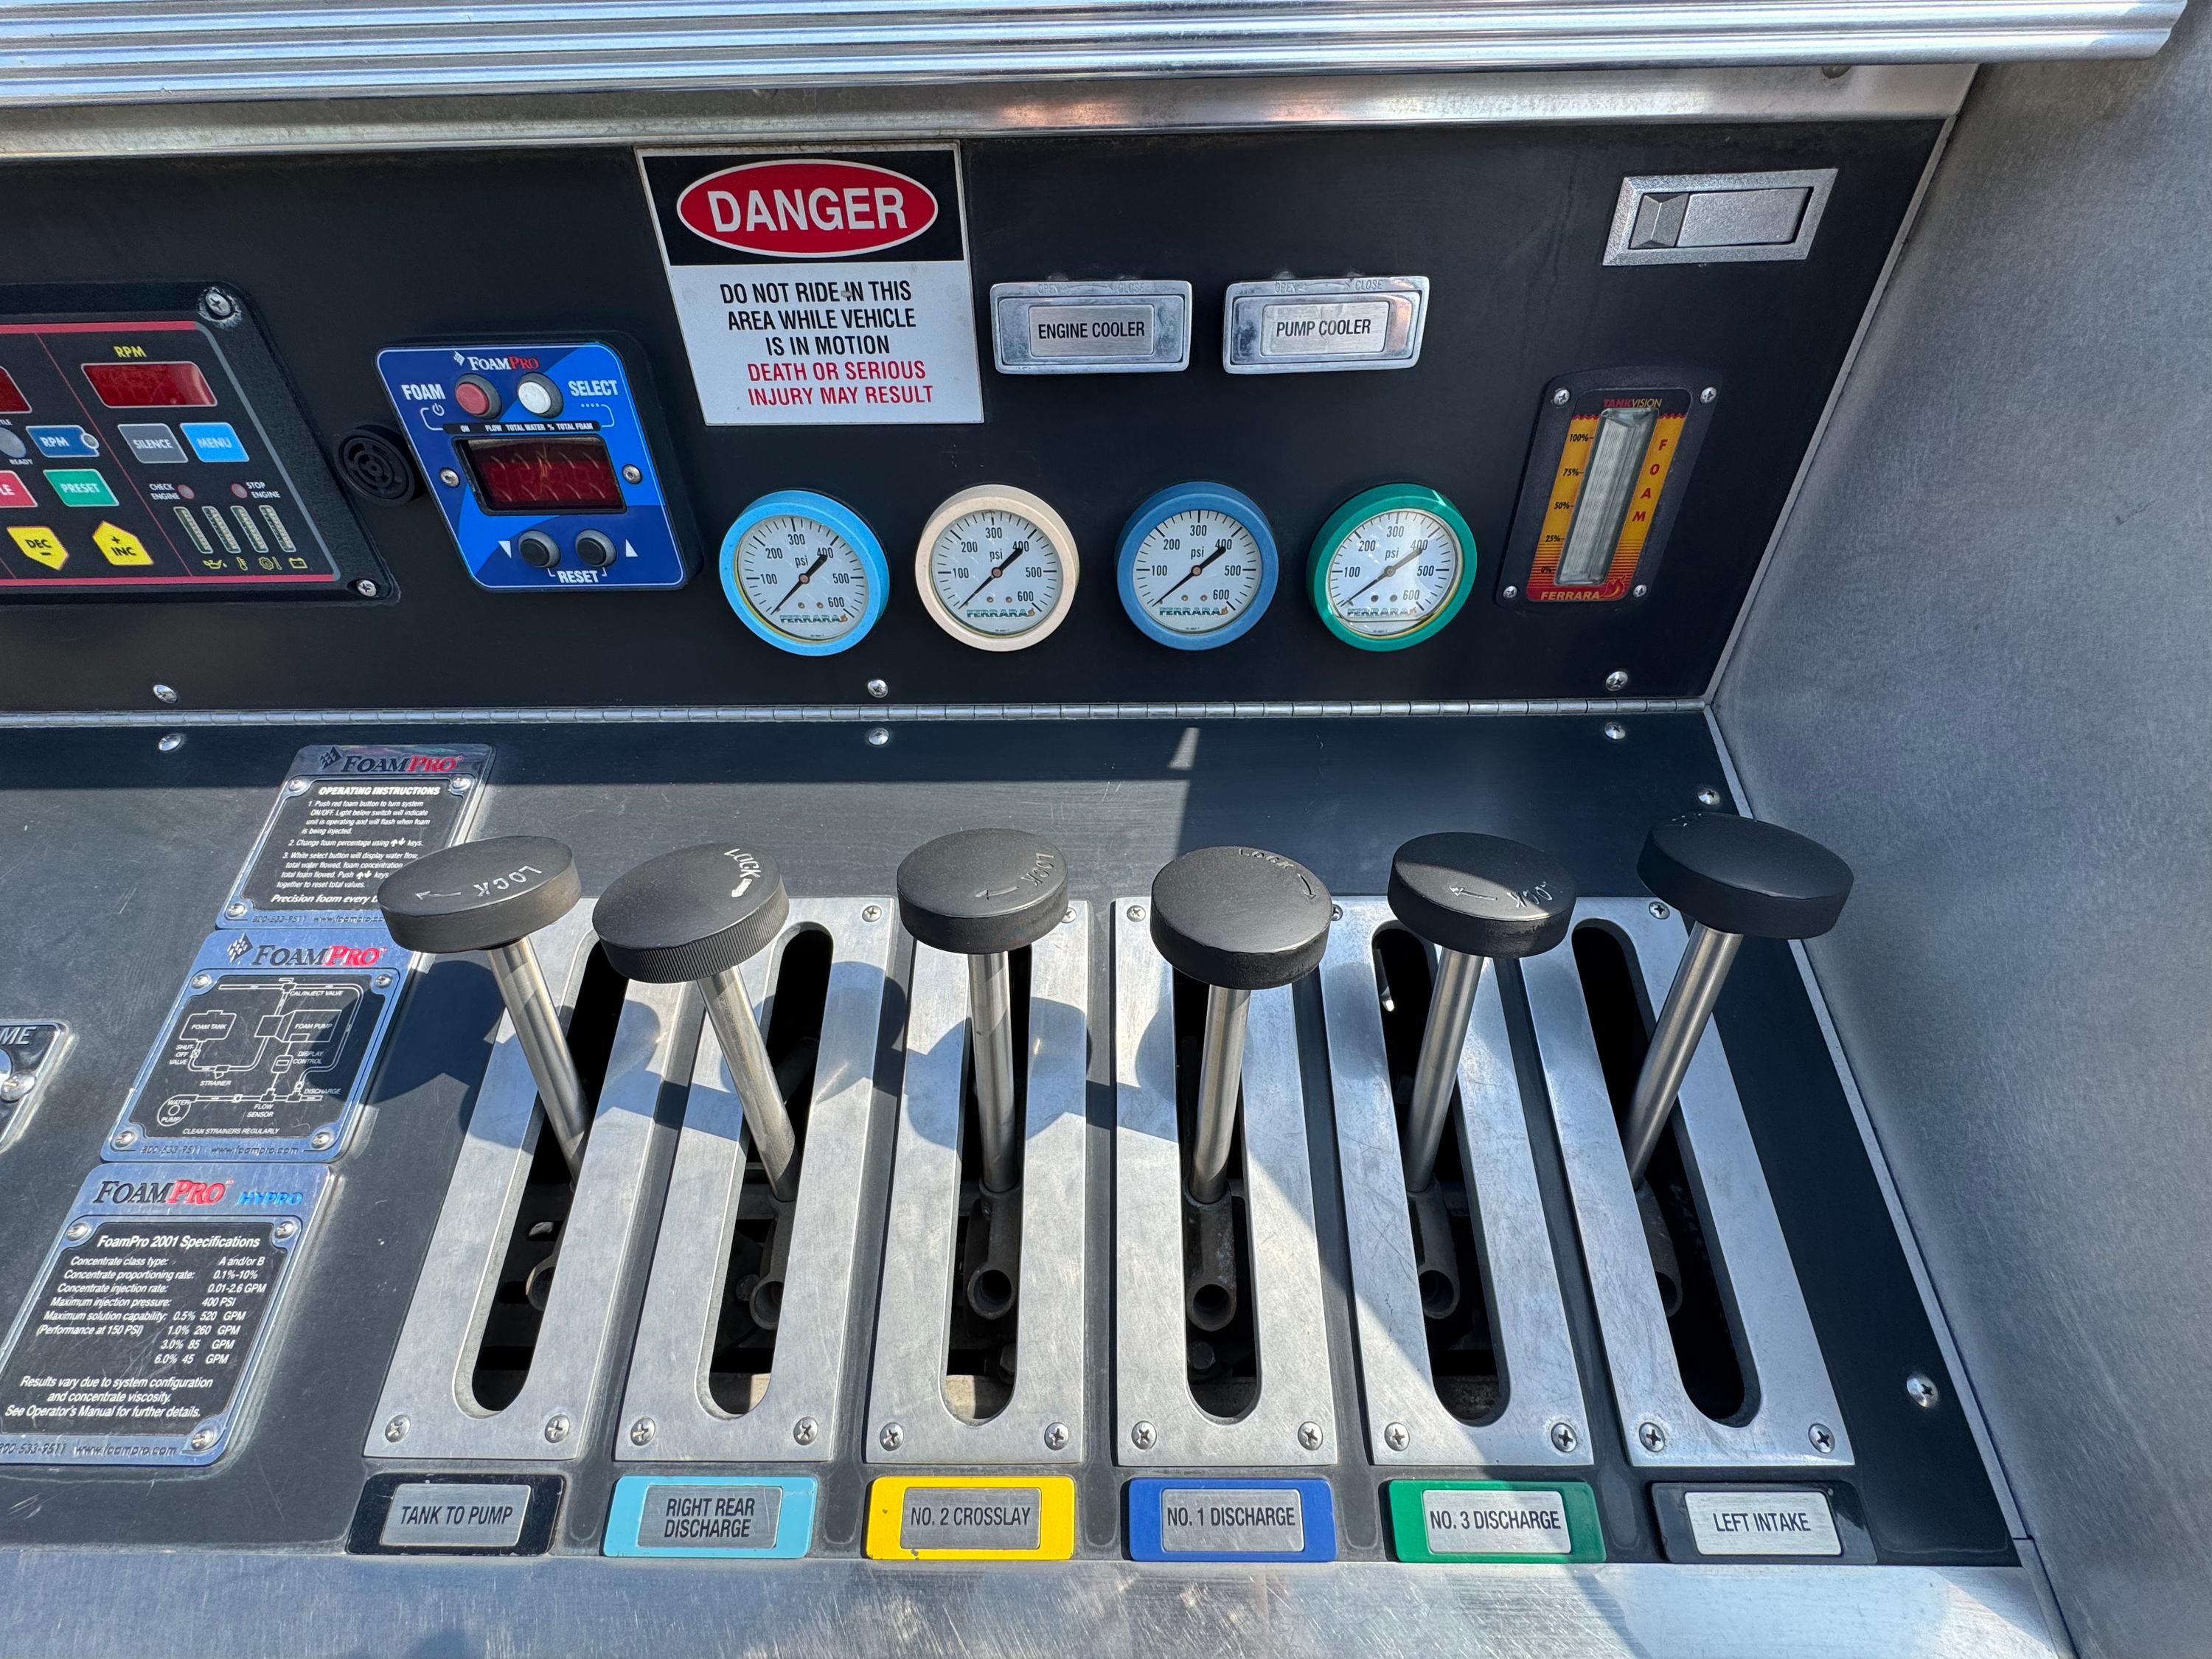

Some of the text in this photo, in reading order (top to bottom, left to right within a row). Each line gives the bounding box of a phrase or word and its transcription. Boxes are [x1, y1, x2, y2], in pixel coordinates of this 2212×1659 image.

[707, 187, 908, 232] DANGER
[720, 280, 912, 304] DO NOT RIDE IN THIS
[1275, 279, 1383, 293] OPEN CLOSE
[728, 308, 917, 330] AREA WHILE VEHICLE
[1038, 321, 1145, 339] ENGINE COOLER
[1276, 319, 1371, 337] PUMP COOLER
[765, 335, 890, 356] IS IN MOTION
[114, 346, 147, 358] RPM
[747, 361, 926, 381] DEATH OR SERIOUS
[401, 384, 445, 400] FOAM
[568, 380, 619, 397] SELECT
[748, 386, 933, 406] INJURY MAY RESULT
[39, 437, 70, 447] RPM
[133, 439, 173, 449] SILENCE
[197, 437, 232, 448] MENU
[1569, 434, 1589, 442] 100%
[1562, 468, 1579, 476] 75%
[60, 483, 100, 493] PRESET
[1554, 501, 1570, 509] 50%
[986, 527, 1003, 539] 300
[1190, 525, 1207, 537] 300
[1386, 526, 1404, 538] 300
[24, 539, 52, 549] DEC
[787, 534, 806, 546] 300
[1012, 540, 1029, 552] 400
[1164, 539, 1180, 551] 200
[1215, 539, 1232, 550] 400
[1358, 540, 1376, 552] 200
[1411, 539, 1428, 551] 400
[111, 547, 136, 556] INC
[816, 547, 834, 559] 400
[961, 541, 978, 553] 200
[1191, 546, 1204, 560] psi
[765, 547, 783, 560] 200
[990, 549, 1003, 563] psi
[1385, 547, 1399, 561] psi
[795, 555, 808, 568] psi
[953, 567, 970, 579] 100
[1026, 567, 1042, 578] 500
[1151, 565, 1168, 576] 100
[1224, 565, 1241, 576] 500
[1344, 566, 1360, 578] 100
[1417, 566, 1434, 577] 500
[557, 570, 599, 584] RESET
[760, 574, 778, 585] 100
[832, 573, 849, 584] 500
[1018, 591, 1034, 602] 600
[1213, 589, 1230, 600] 600
[1402, 590, 1420, 600] 600
[1540, 591, 1601, 601] FERRARA
[828, 597, 845, 608] 600
[967, 609, 1028, 618] FERRARA
[1159, 607, 1221, 616] FERRARA
[319, 786, 441, 796] OPERATING INSTRUCTIONS
[724, 847, 762, 880] LOCK
[1239, 848, 1295, 869] LOCK
[1020, 852, 1055, 886] LOCK
[473, 865, 543, 898] LOCK
[271, 894, 369, 905] Precision foam every
[236, 1191, 304, 1205] HYPRO
[97, 1234, 261, 1249] FoamPro 2001 Specifications
[70, 1256, 169, 1267] Concentrate class type:
[218, 1256, 265, 1266] A and/or B
[63, 1269, 195, 1281] Concentrate proportioning rate:
[212, 1270, 258, 1280] 0.1%-10%
[57, 1283, 169, 1295] Concentrate injection rate:
[207, 1283, 268, 1293] 0.01-2.6 GPM
[50, 1297, 173, 1309] Maximum injection pressure:
[201, 1297, 237, 1307] 400 PSI
[666, 1498, 756, 1517] RIGHT REAR
[400, 1506, 513, 1525] TANK TO PUMP
[911, 1506, 1031, 1526] NO. 2 CROSSLAY
[1167, 1507, 1296, 1526] NO. 1 DISCHARGE
[1430, 1510, 1562, 1530] NO. 3 DISCHARGE
[664, 1518, 751, 1538] DISCHARGE
[1713, 1512, 1812, 1532] LEFT INTAKE
